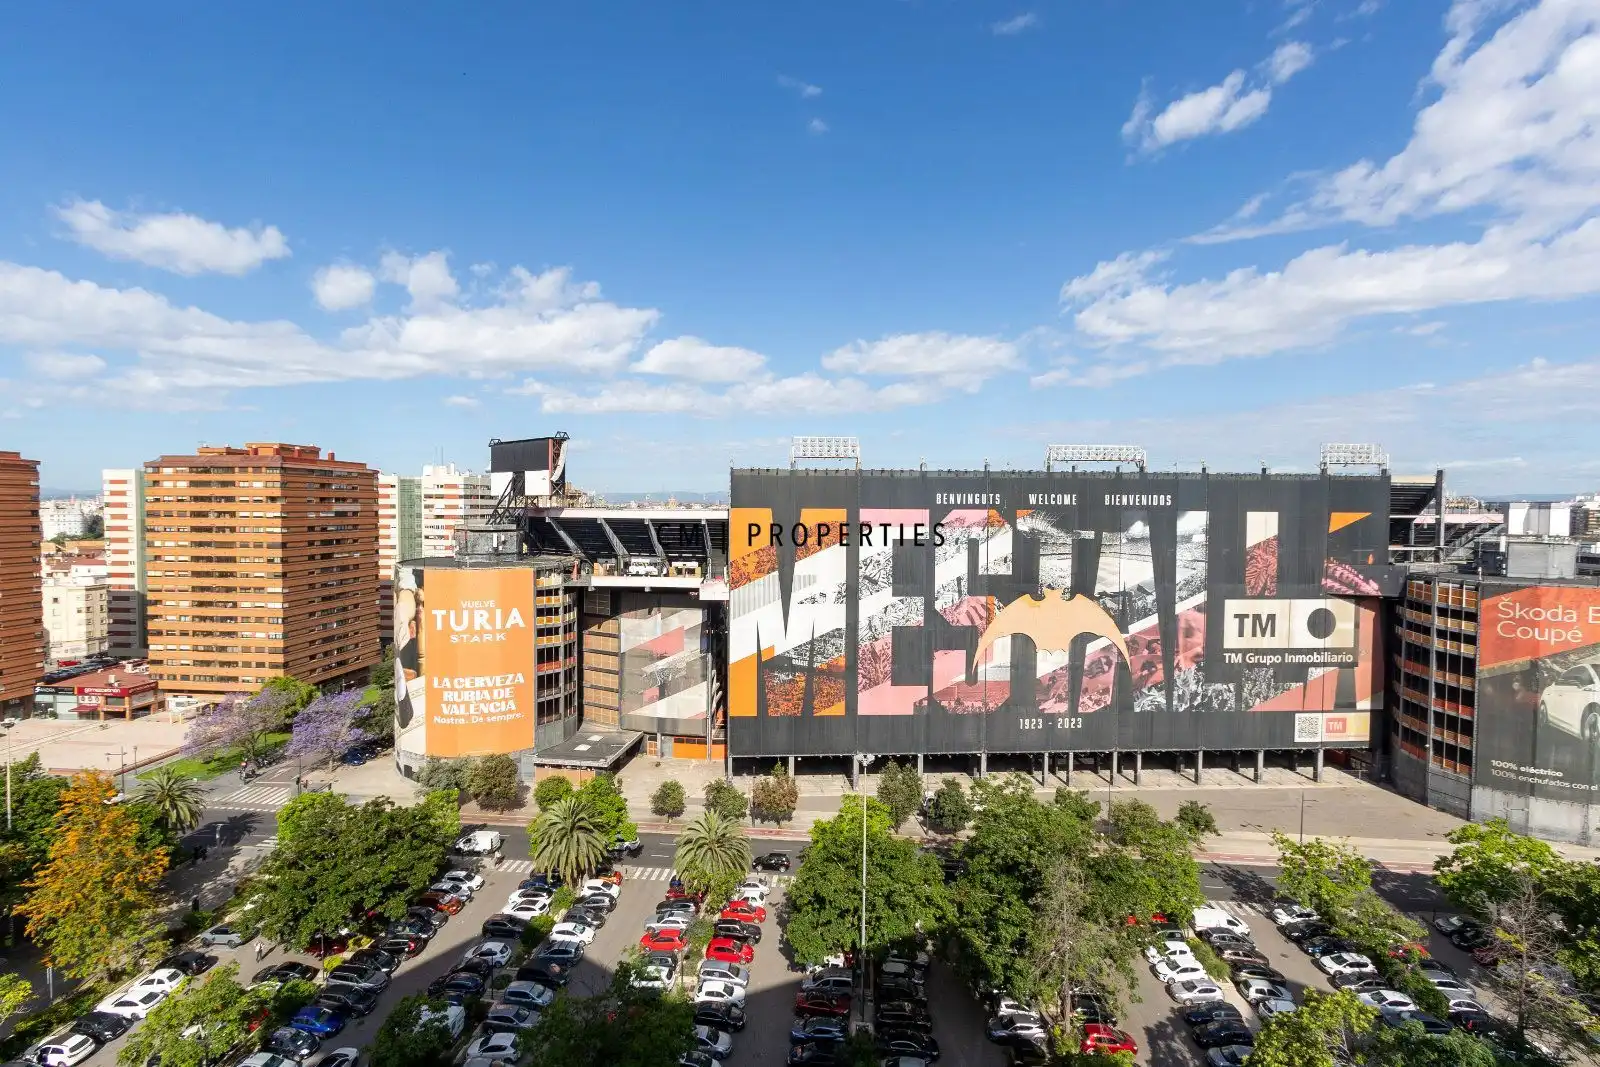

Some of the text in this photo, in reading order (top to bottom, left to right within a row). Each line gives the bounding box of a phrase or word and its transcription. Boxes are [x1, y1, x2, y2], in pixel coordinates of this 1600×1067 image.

[936, 493, 1172, 506] BENVINGUTS WELCOME BIENVENIDOS
[461, 600, 496, 608] VUELVE
[1497, 596, 1577, 622] Škoda
[431, 607, 526, 632] TURIA
[1233, 613, 1276, 637] TM
[450, 632, 506, 643] STARK
[1496, 620, 1583, 646] Coupé
[1224, 651, 1354, 666] TM Grupo Inmobiliario
[433, 672, 525, 689] LA CERVEZA
[442, 687, 514, 702] RUBIA DE
[441, 700, 516, 715] VALENCIA
[433, 715, 469, 725] Nostra.
[486, 712, 525, 723] sempre.
[1019, 718, 1043, 730] 1923
[1057, 717, 1082, 729] 2023
[1328, 721, 1344, 731] TM
[1491, 760, 1564, 777] 100% eléctrico
[1491, 768, 1517, 780] 100%
[1518, 775, 1571, 788] enchufados
